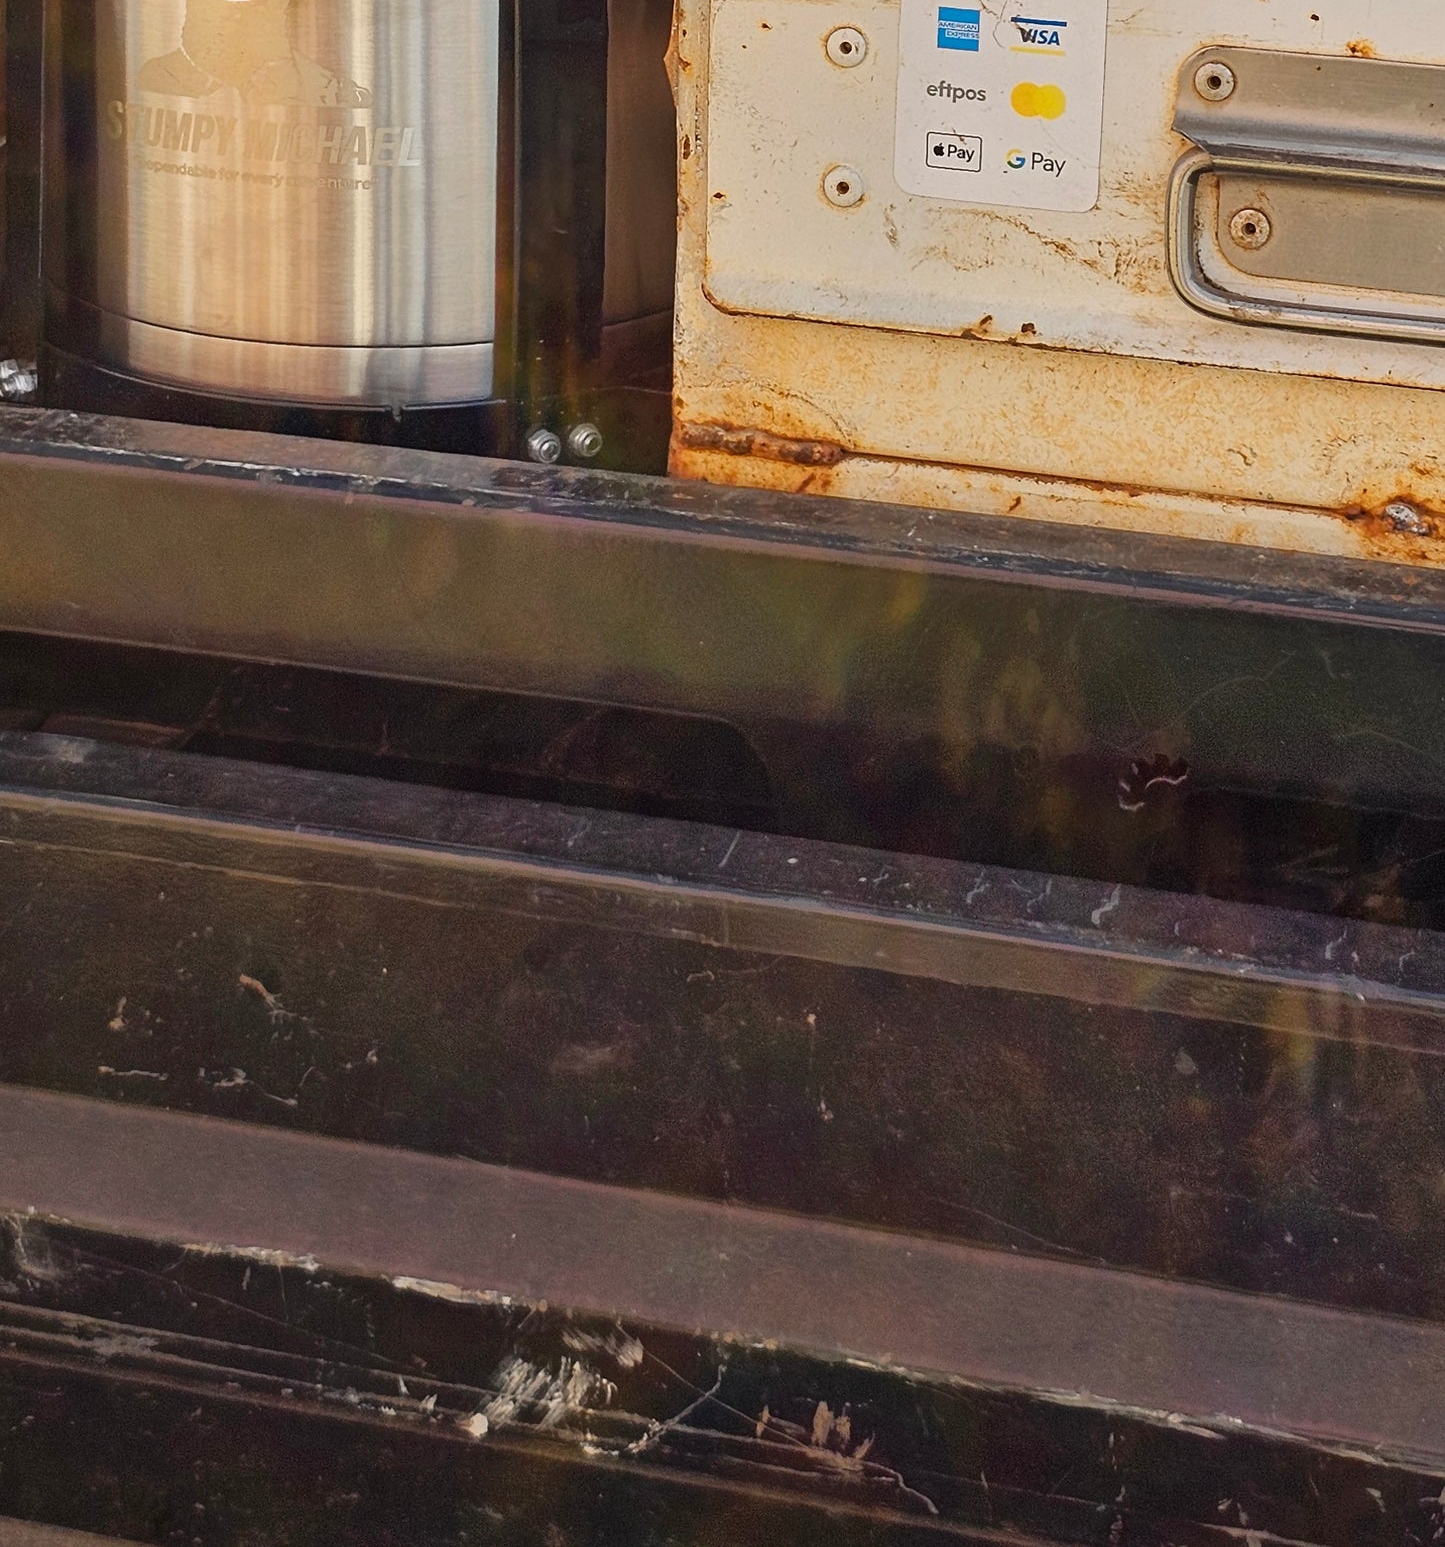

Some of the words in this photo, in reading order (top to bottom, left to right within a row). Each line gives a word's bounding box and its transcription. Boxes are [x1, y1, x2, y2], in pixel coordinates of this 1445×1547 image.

[1019, 26, 1061, 46] VISA
[926, 81, 987, 103] eftpos
[105, 99, 240, 157] STUMPY
[243, 119, 421, 167] MICHAEL
[947, 143, 975, 163] Pay
[139, 158, 217, 179] ependable
[1031, 151, 1067, 178] Pay
